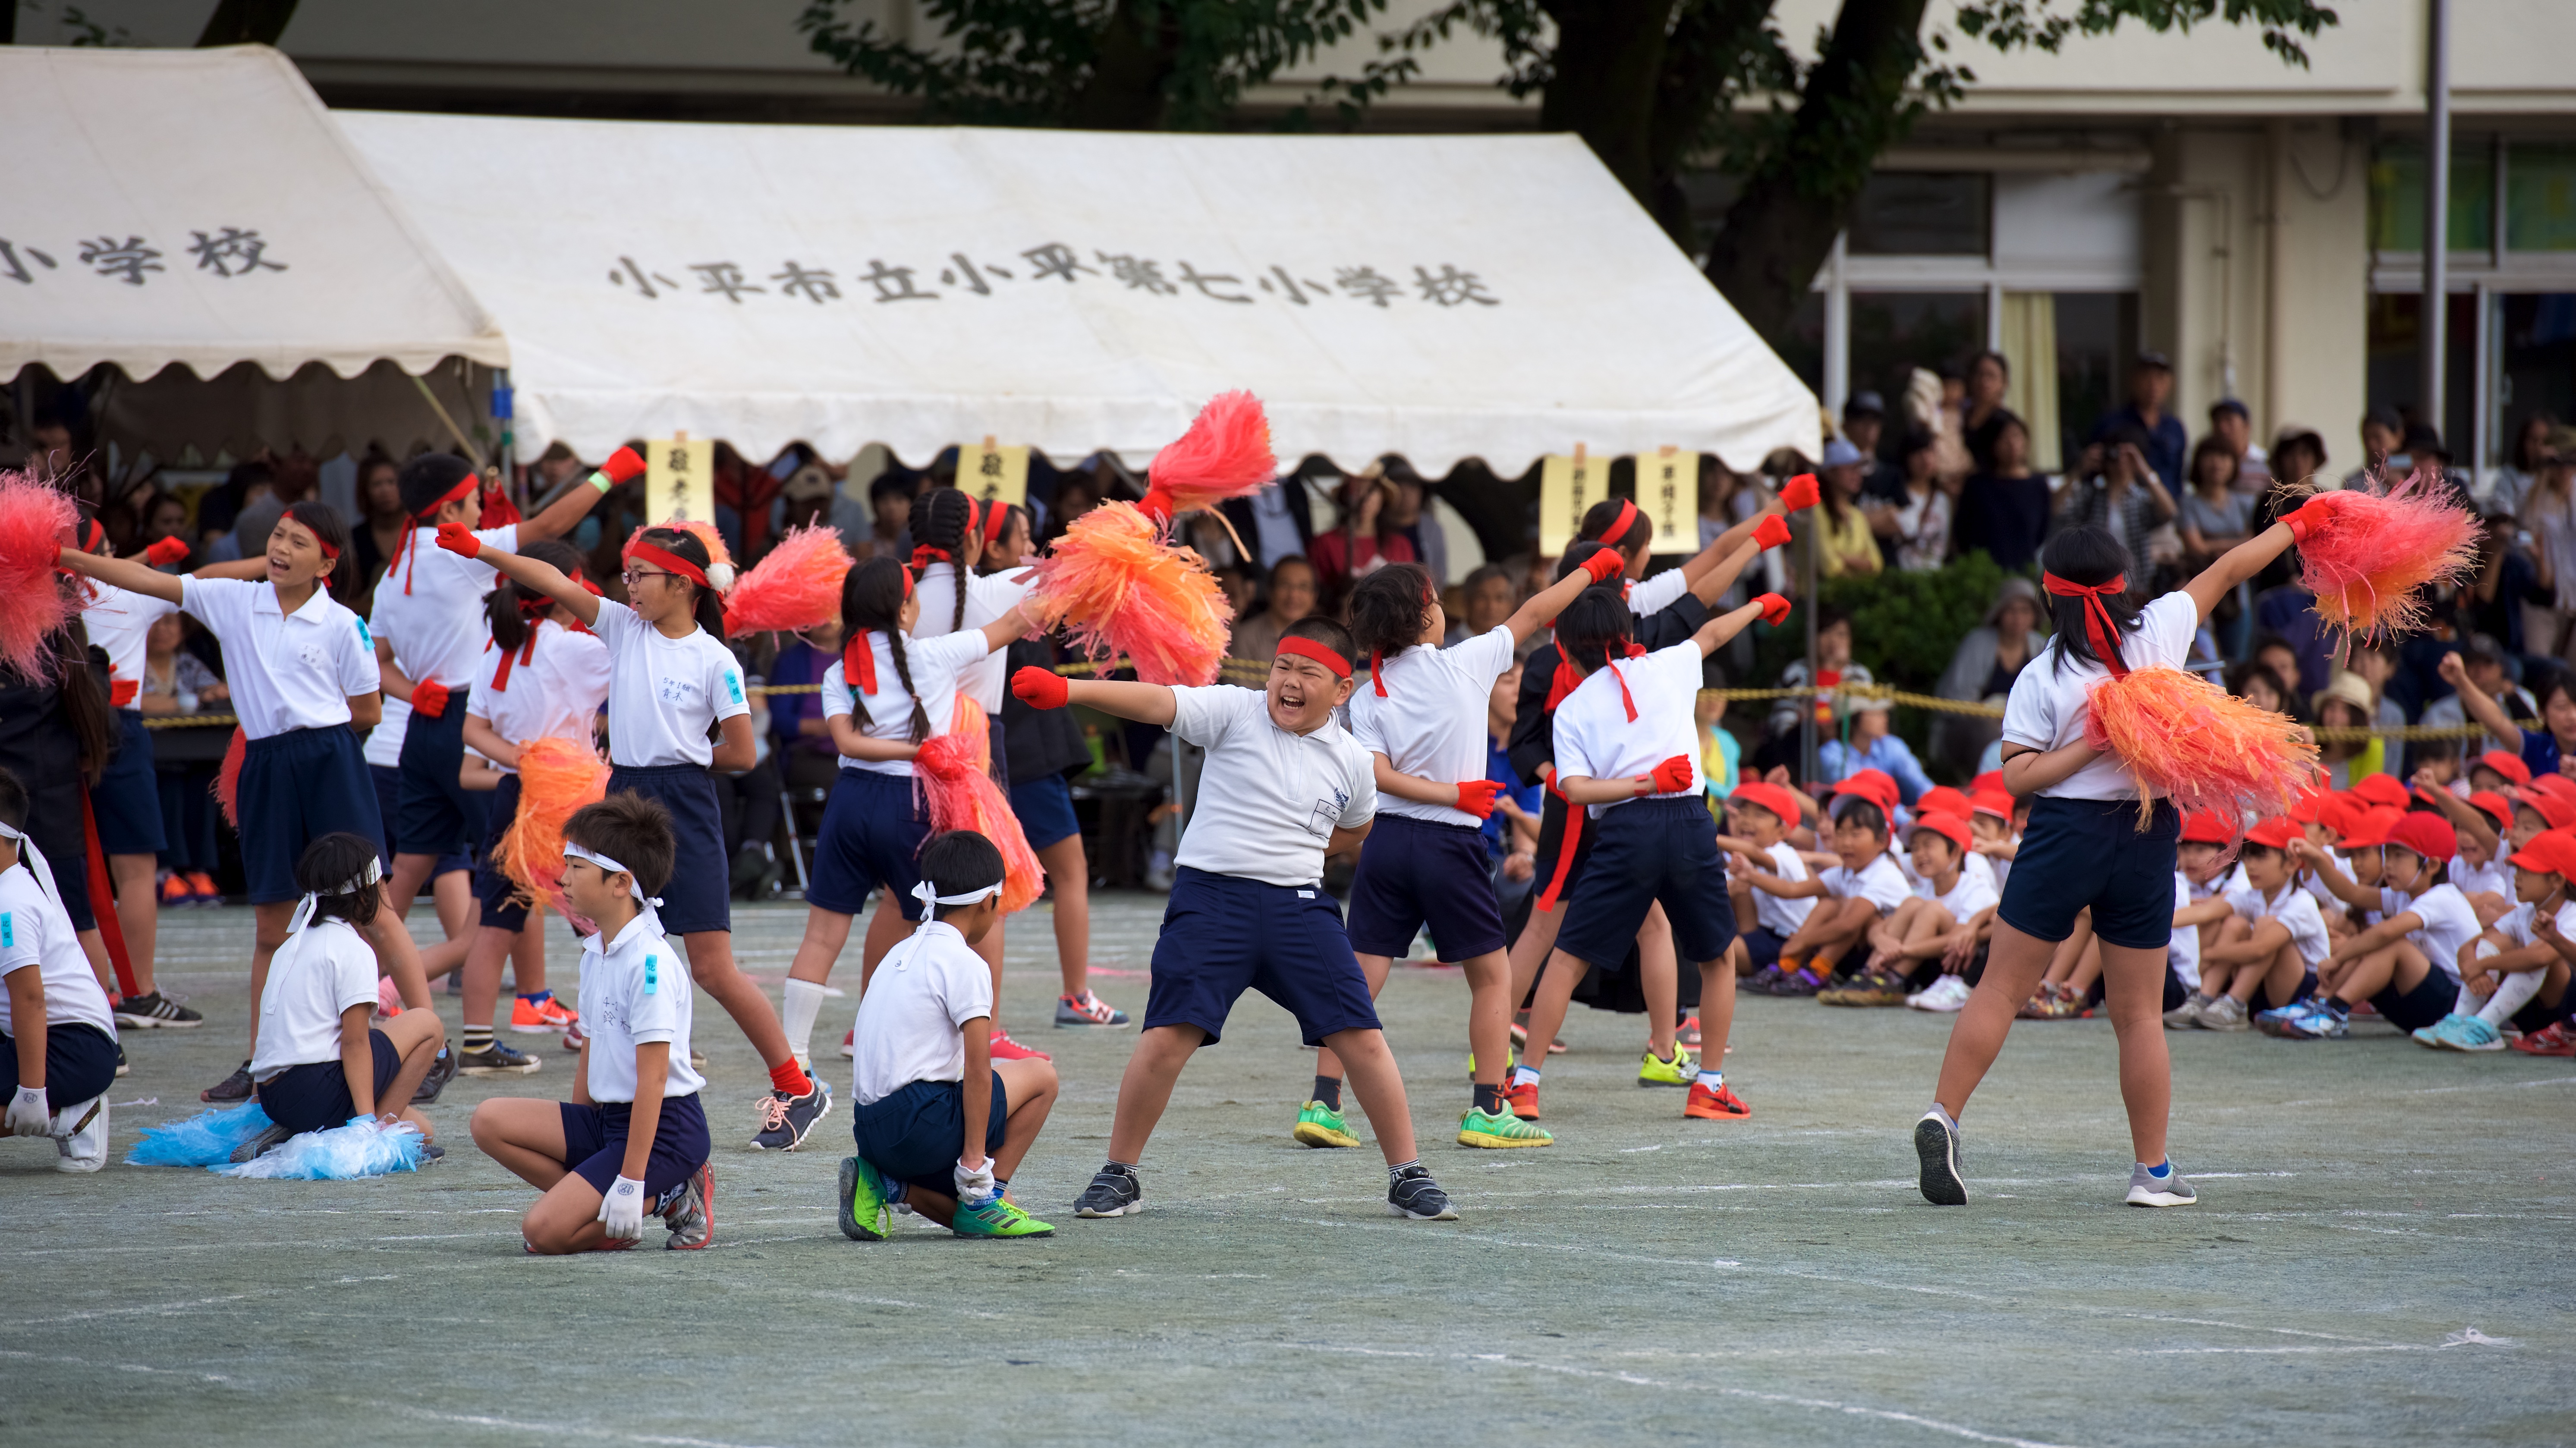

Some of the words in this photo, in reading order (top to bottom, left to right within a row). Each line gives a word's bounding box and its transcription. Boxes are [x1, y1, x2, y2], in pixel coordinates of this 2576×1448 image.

[0, 227, 288, 285] 小学校
[609, 242, 1500, 307] 小平市立小平第七小学校
[663, 688, 683, 702] 青木
[603, 997, 618, 1011] 4-2
[603, 1011, 631, 1030] 鈴木
[883, 1174, 892, 1199] didas
